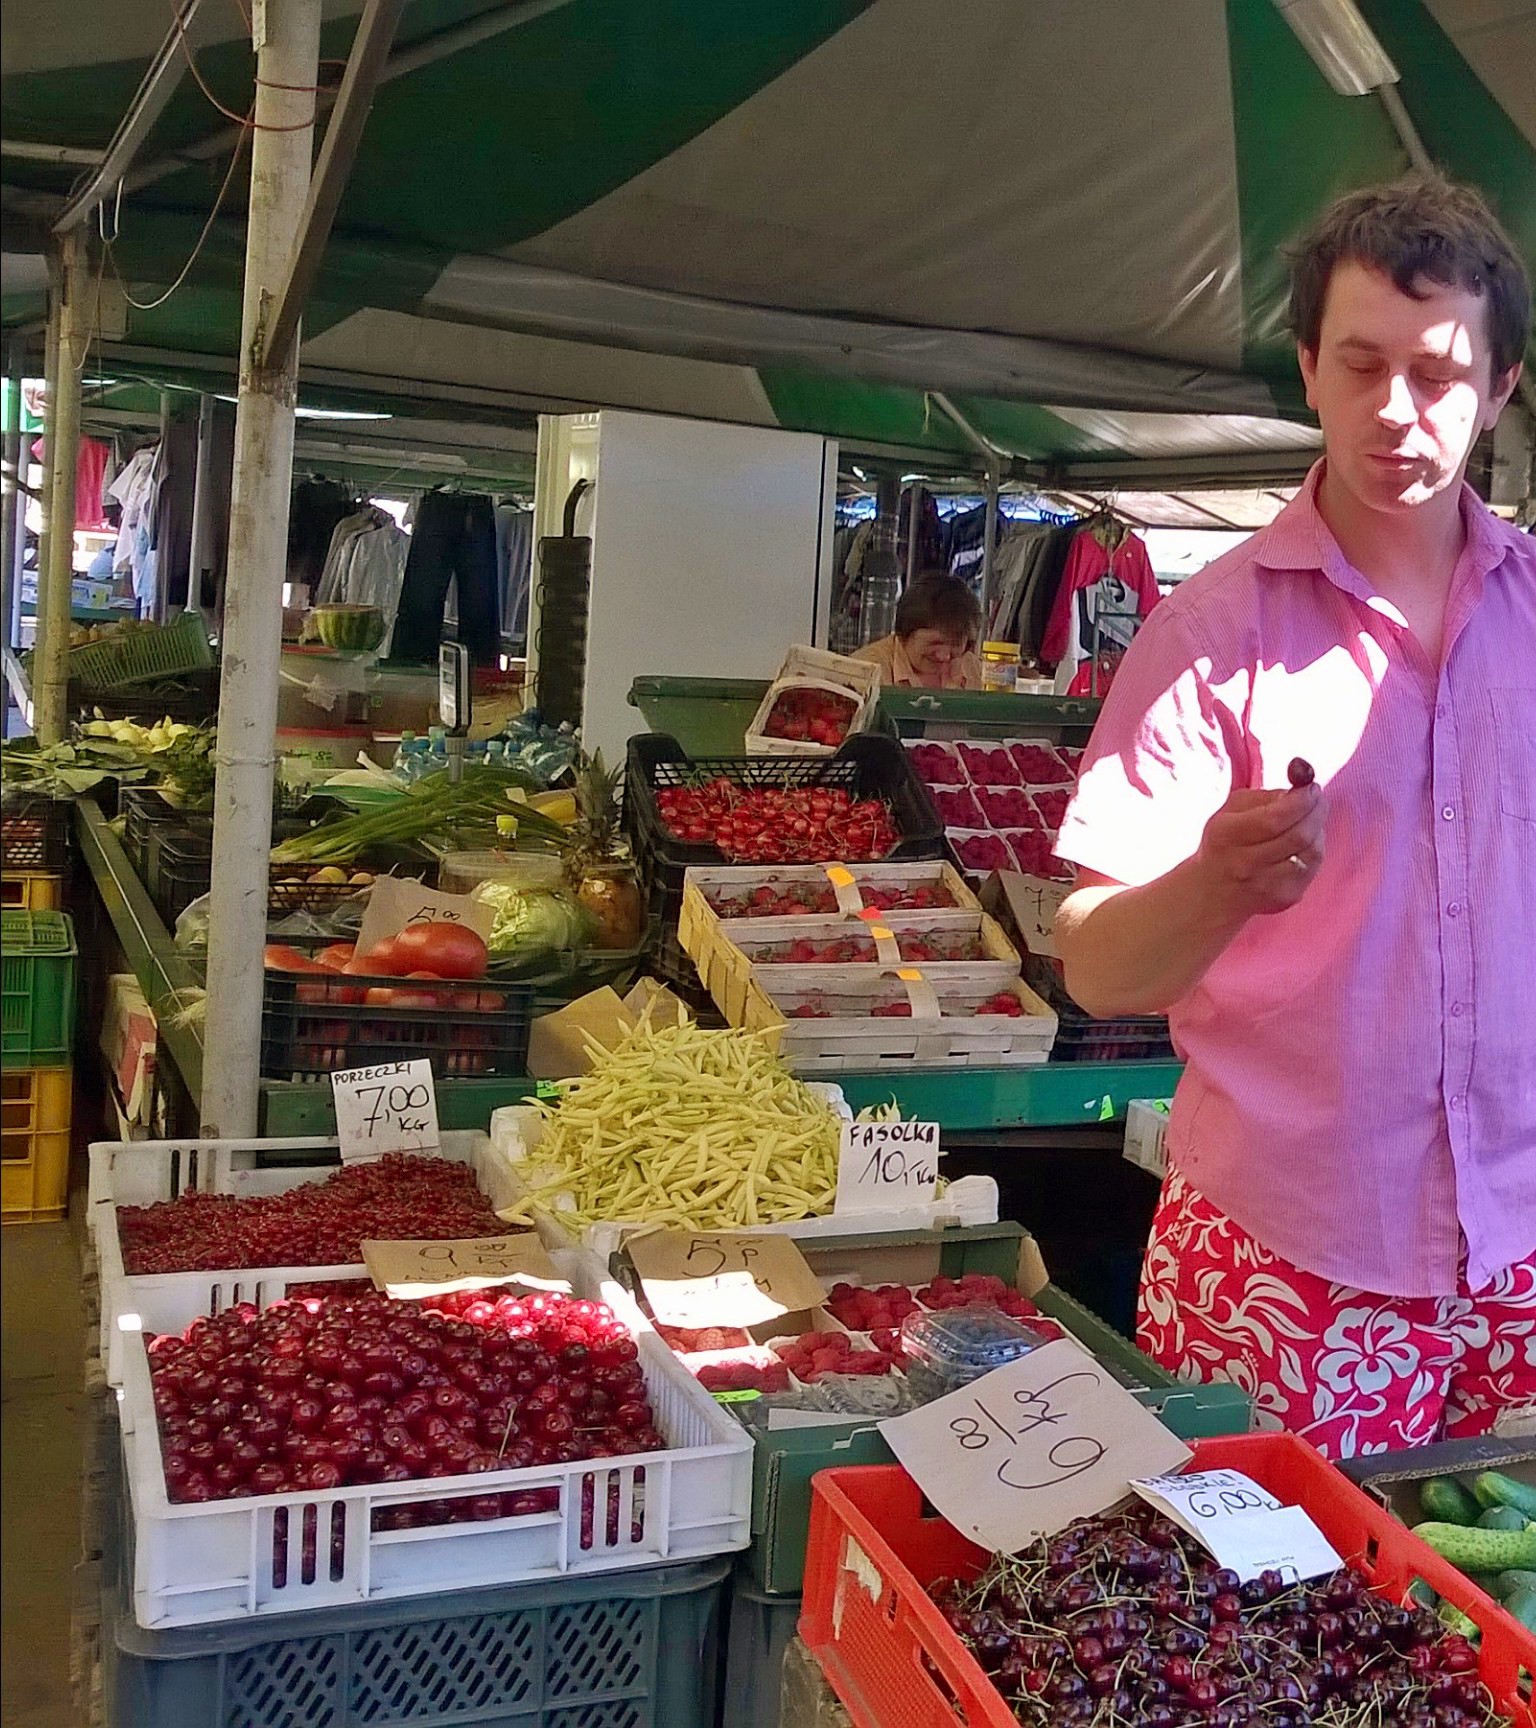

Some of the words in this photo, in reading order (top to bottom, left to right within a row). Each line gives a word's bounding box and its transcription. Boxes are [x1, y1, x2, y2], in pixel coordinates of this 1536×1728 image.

[333, 1062, 412, 1086] PORZECZKI
[354, 1084, 430, 1138] 7,00
[1188, 1489, 1262, 1518] 6,00
